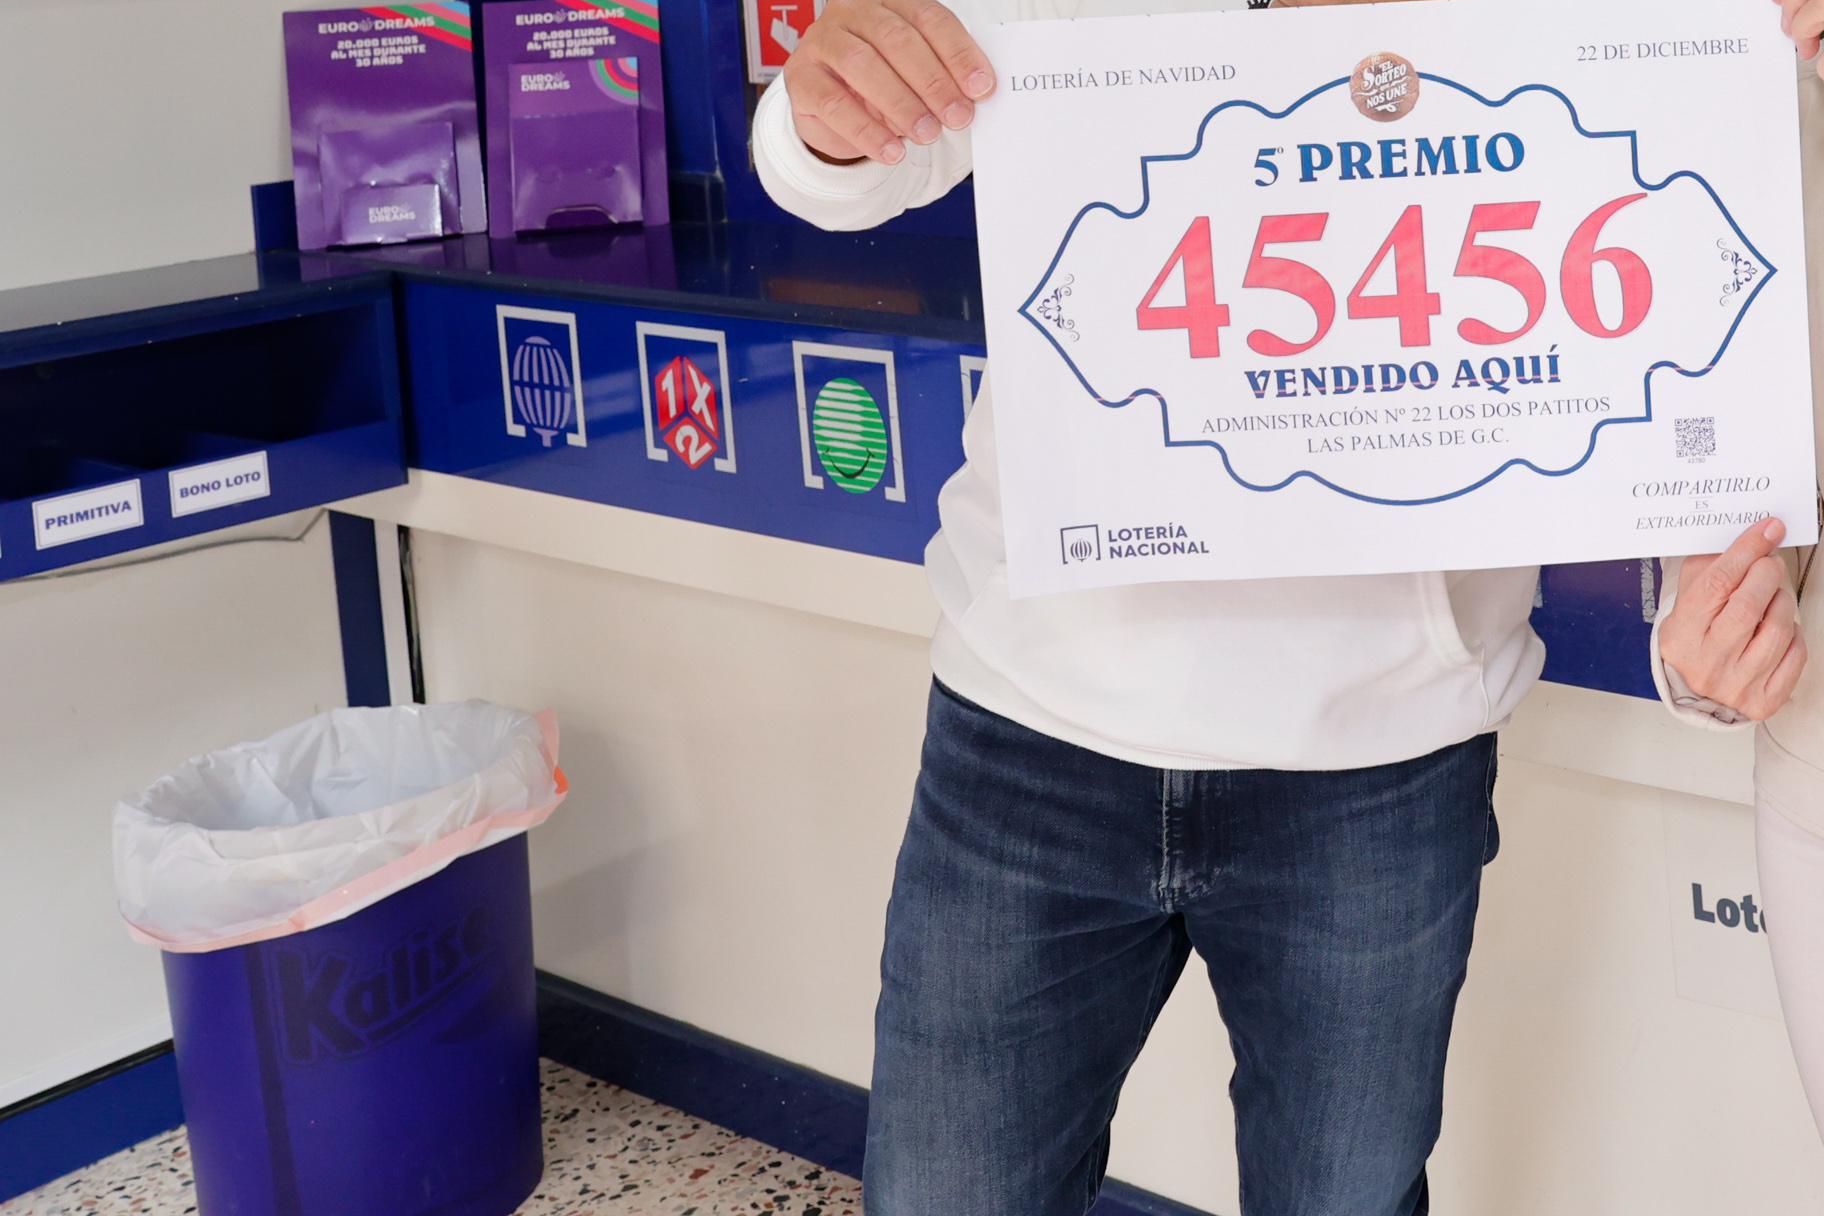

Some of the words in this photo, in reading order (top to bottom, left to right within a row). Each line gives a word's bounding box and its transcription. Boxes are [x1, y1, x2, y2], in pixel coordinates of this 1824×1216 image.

[1577, 45, 1597, 61] 22
[1603, 45, 1631, 60] DE
[1637, 39, 1749, 58] DICIEMBRE
[1012, 68, 1098, 91] LOTERÍA
[1105, 70, 1132, 86] DE
[1139, 65, 1235, 84] NAVIDAD
[1297, 133, 1524, 182] PREMIO
[1137, 193, 1652, 359] 45456
[1244, 361, 1438, 398] VENDIDO
[1452, 344, 1560, 394] AQUÍ
[1203, 405, 1377, 433] ADMINISTRACIÓN
[1412, 407, 1431, 422] 22
[1438, 405, 1475, 420] LOS
[1482, 402, 1521, 418] DOS
[1529, 397, 1610, 415] PATITOS
[1308, 437, 1344, 453] LAS
[1352, 433, 1432, 450] PALMAS
[1439, 429, 1467, 445] DE
[1473, 428, 1510, 444] G.C.
[180, 480, 221, 498] BONO
[226, 471, 261, 488] LOTO
[1633, 477, 1770, 496] COMPARTIRLO
[45, 501, 131, 530] PRIMITIVA
[1108, 523, 1187, 542] LOTERÍA
[1110, 542, 1209, 558] NACIONAL
